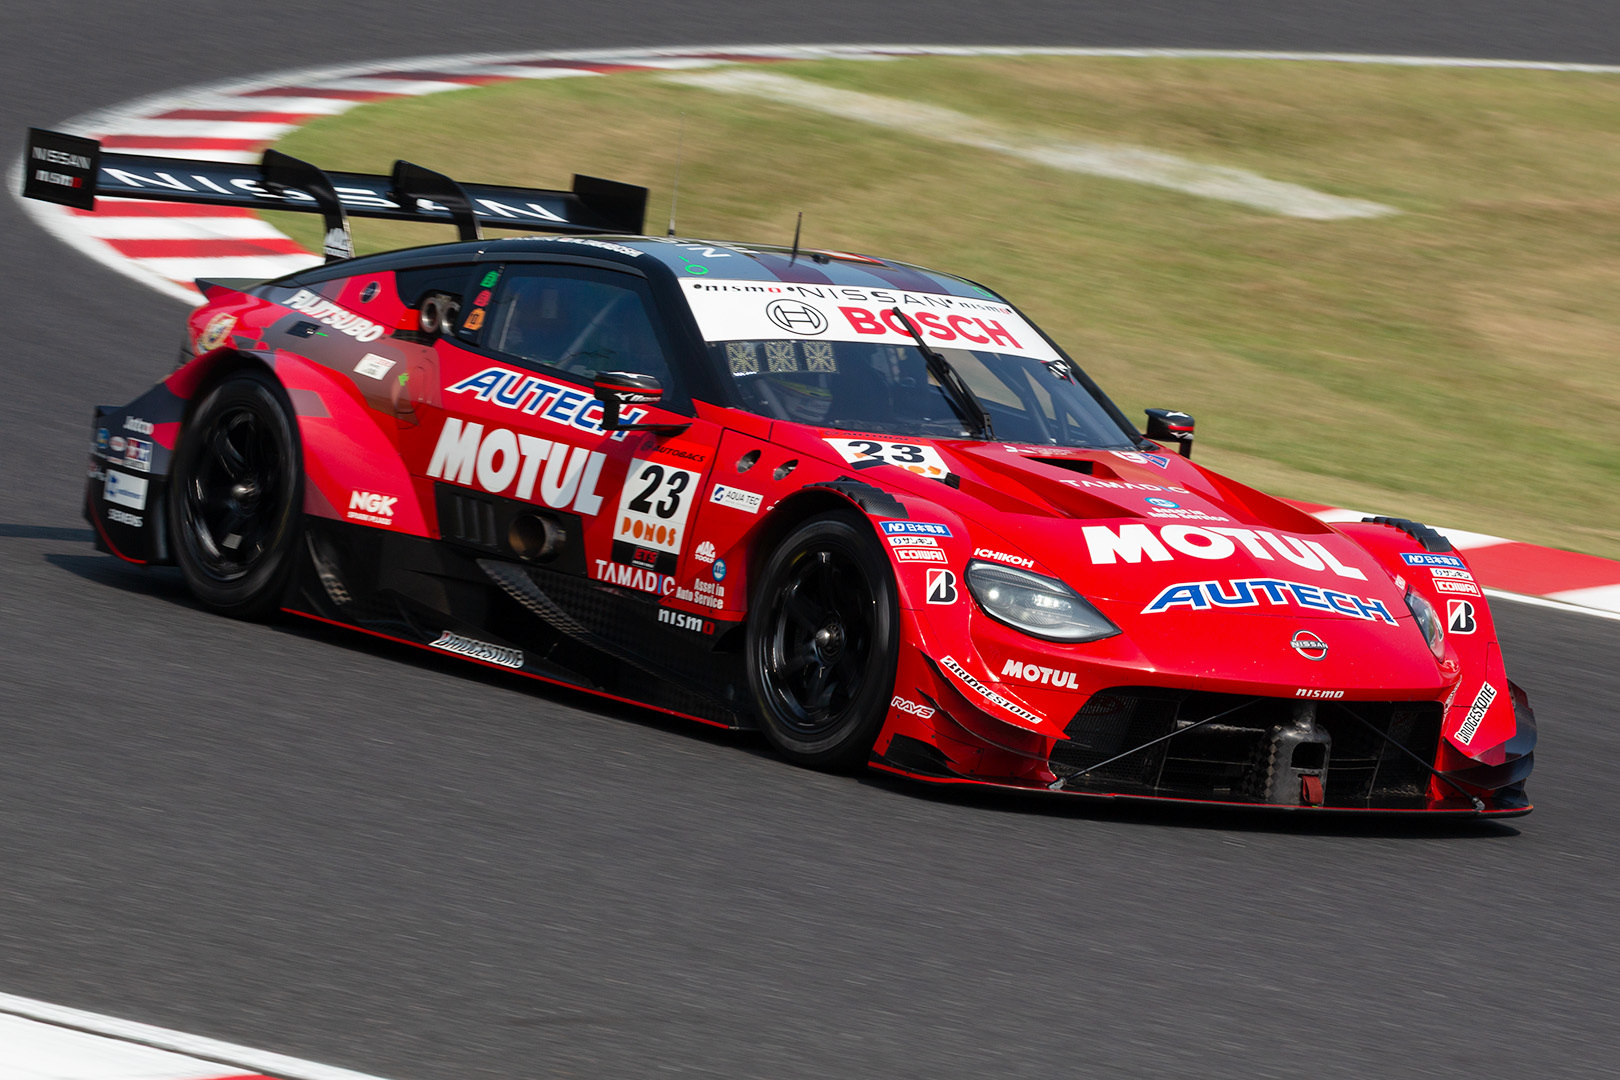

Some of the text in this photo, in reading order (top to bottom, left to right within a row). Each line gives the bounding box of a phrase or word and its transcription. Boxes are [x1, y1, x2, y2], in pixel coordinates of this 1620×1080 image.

[32, 146, 91, 170] NISSAN
[705, 285, 782, 293] nismo
[797, 286, 951, 309] NISSAN
[959, 302, 1011, 315] nismo
[837, 306, 1024, 349] BOSCH
[653, 445, 706, 462] AUTOBACS
[847, 441, 925, 464] 23
[426, 417, 607, 516] MOTUL
[628, 464, 690, 519] 23
[726, 490, 744, 502] AQUA
[747, 495, 760, 506] TEC
[1059, 479, 1190, 495] TAMADIC
[349, 490, 398, 516] NGK
[621, 516, 677, 547] PONOS
[634, 548, 657, 563] ETS
[974, 548, 1034, 568] ICHIKOH
[1081, 524, 1369, 581] MOTUL
[595, 559, 676, 596] TAMADIC
[694, 578, 724, 597] Asset in
[676, 586, 724, 609] Auto Service
[1140, 578, 1400, 627] AUTECH
[658, 608, 716, 635] nismo
[430, 631, 523, 668] BRIDGESTONE
[1291, 641, 1329, 650] NISSAN
[1001, 659, 1079, 690] MOTUL
[942, 656, 1042, 723] BRIDGESTONE
[1296, 688, 1345, 699] nismo
[891, 696, 935, 719] RAYS
[1455, 682, 1497, 745] BRIDGESTONE
